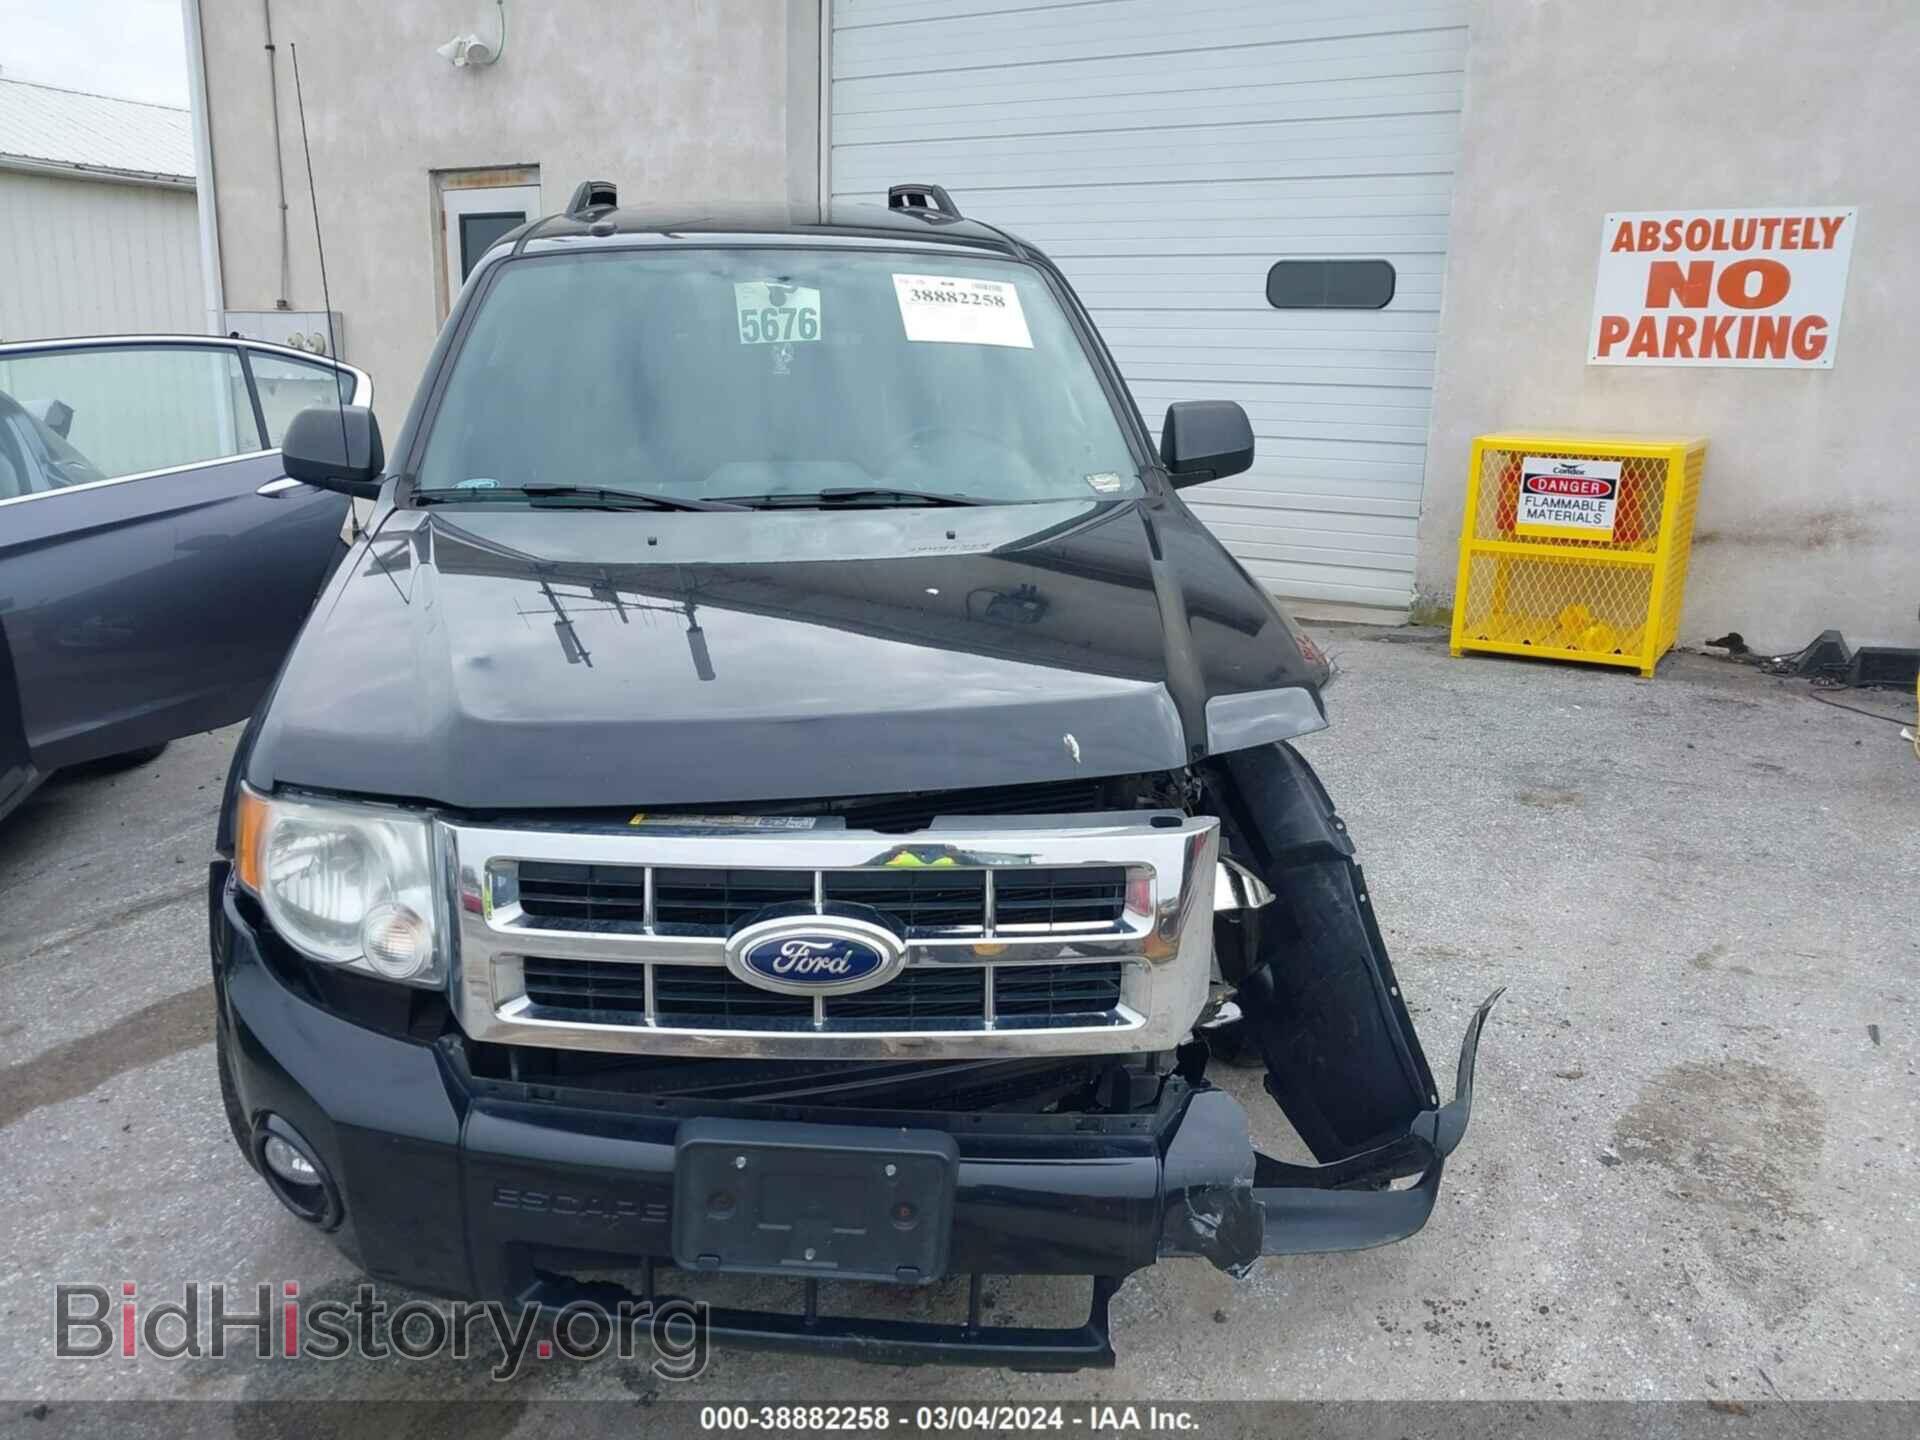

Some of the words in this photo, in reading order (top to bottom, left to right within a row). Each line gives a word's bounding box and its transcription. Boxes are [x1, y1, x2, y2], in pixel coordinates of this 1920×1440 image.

[1610, 216, 1846, 252] ABSOLUTELY
[1645, 258, 1791, 310] NO
[910, 288, 1006, 308] 38882258
[740, 307, 818, 342] 5676
[1597, 314, 1829, 361] PARKING
[1552, 466, 1586, 475] Condor
[1538, 479, 1600, 493] DANGER
[1525, 496, 1607, 512] FLAMMABLE
[1527, 509, 1602, 524] MATERIALS
[772, 940, 853, 974] Ford
